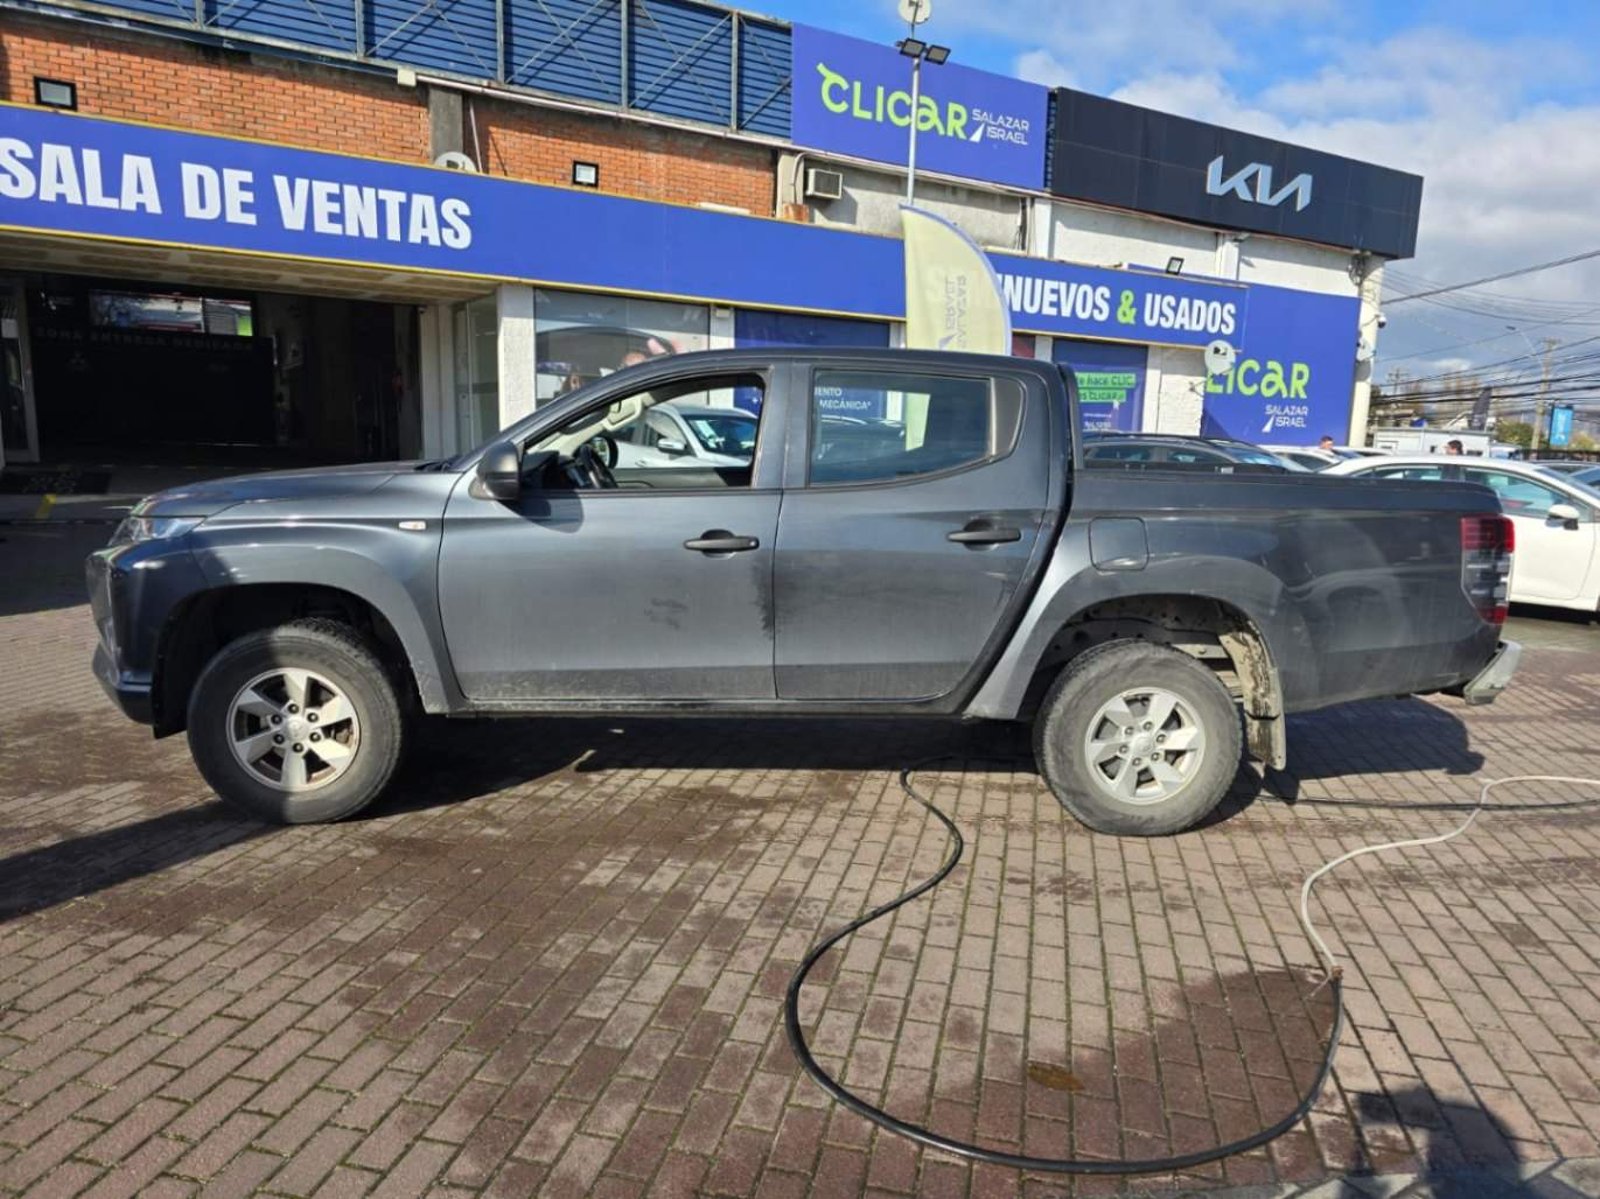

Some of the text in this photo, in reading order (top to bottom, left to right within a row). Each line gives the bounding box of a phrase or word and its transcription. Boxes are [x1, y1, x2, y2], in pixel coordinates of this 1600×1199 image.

[971, 109, 1029, 132] SALAZAR
[985, 126, 1028, 145] ISRAEL
[0, 137, 472, 250] SALA DE VENTAS
[1117, 290, 1136, 324] &
[1144, 293, 1237, 335] USADOS
[1265, 404, 1308, 416] SALAZAR
[1275, 416, 1306, 428] ISRAEL
